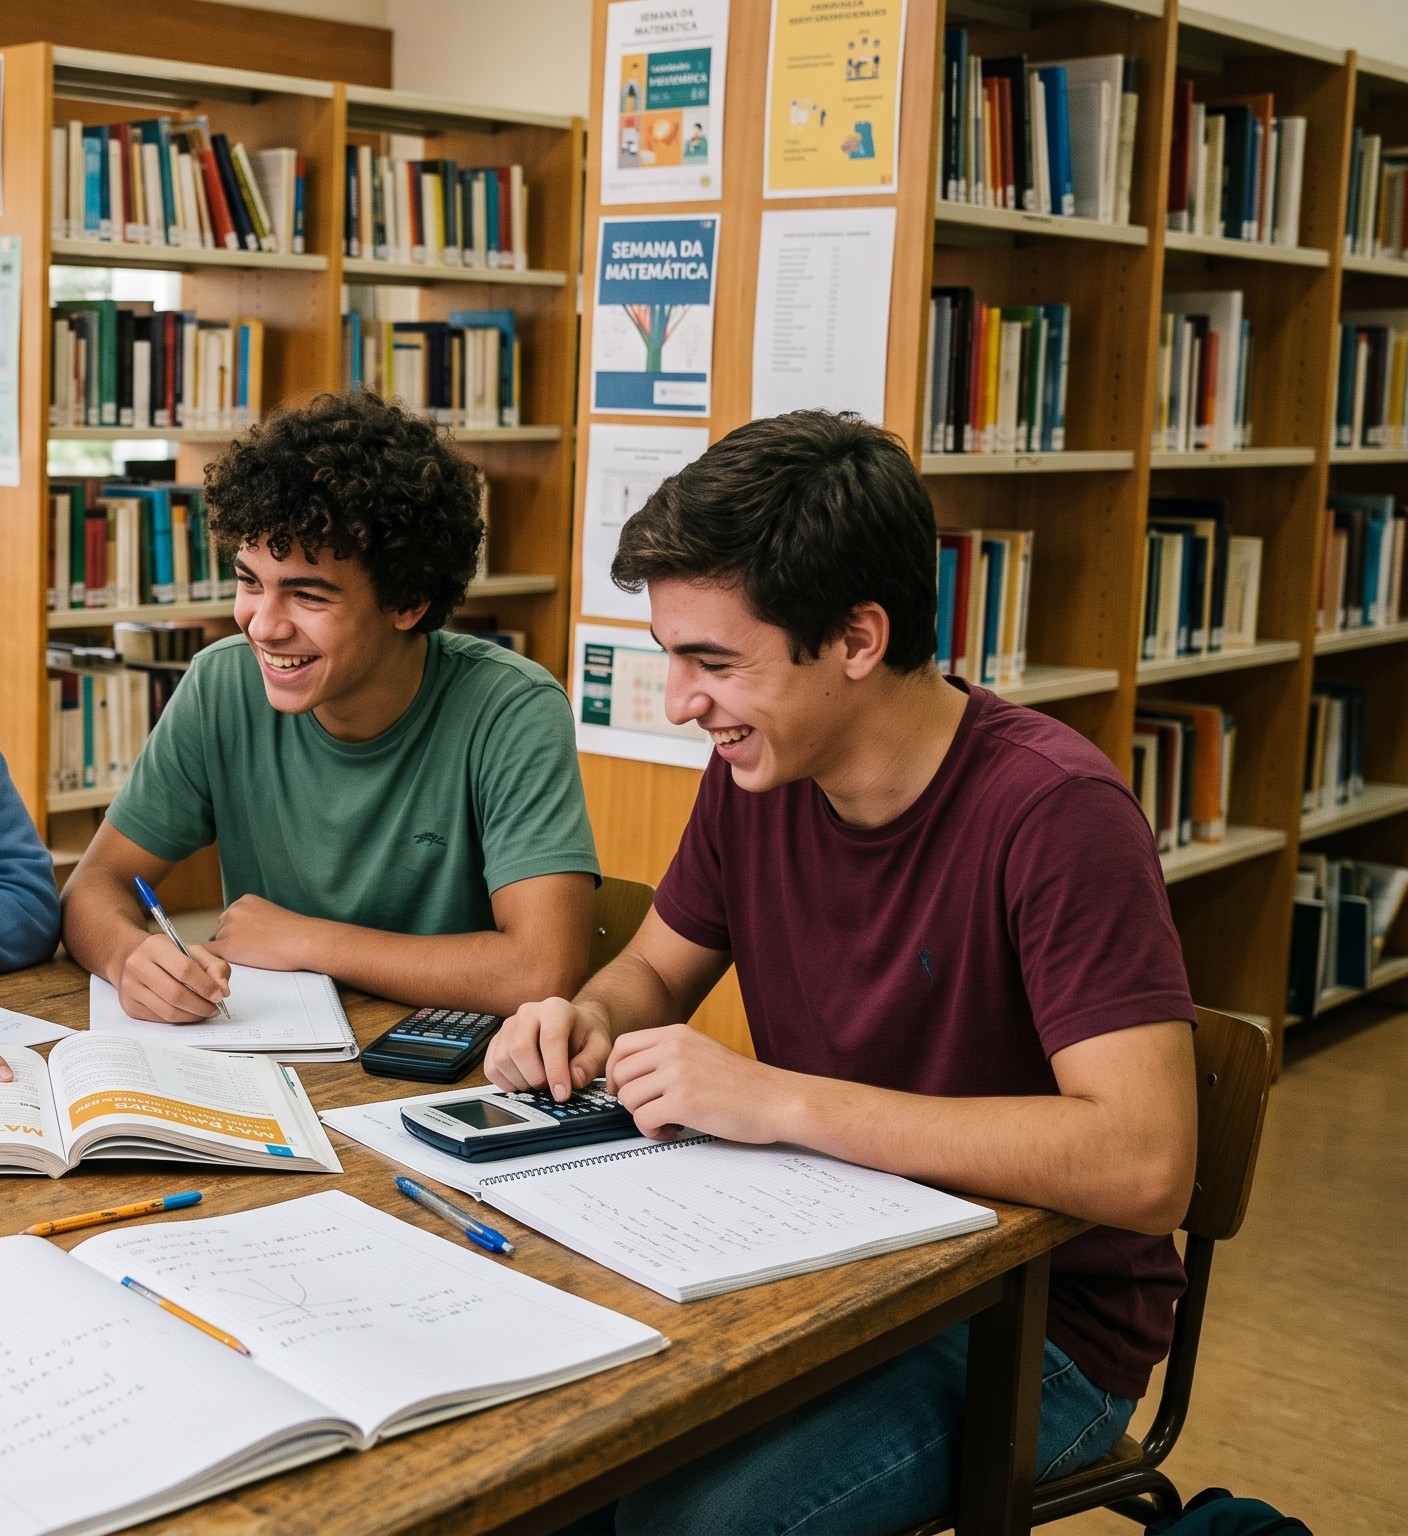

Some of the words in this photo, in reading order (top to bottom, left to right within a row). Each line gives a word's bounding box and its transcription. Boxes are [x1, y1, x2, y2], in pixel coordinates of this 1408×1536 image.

[612, 240, 678, 259] SEMANA
[680, 239, 704, 258] DA
[604, 258, 709, 280] MATEMÁTICA
